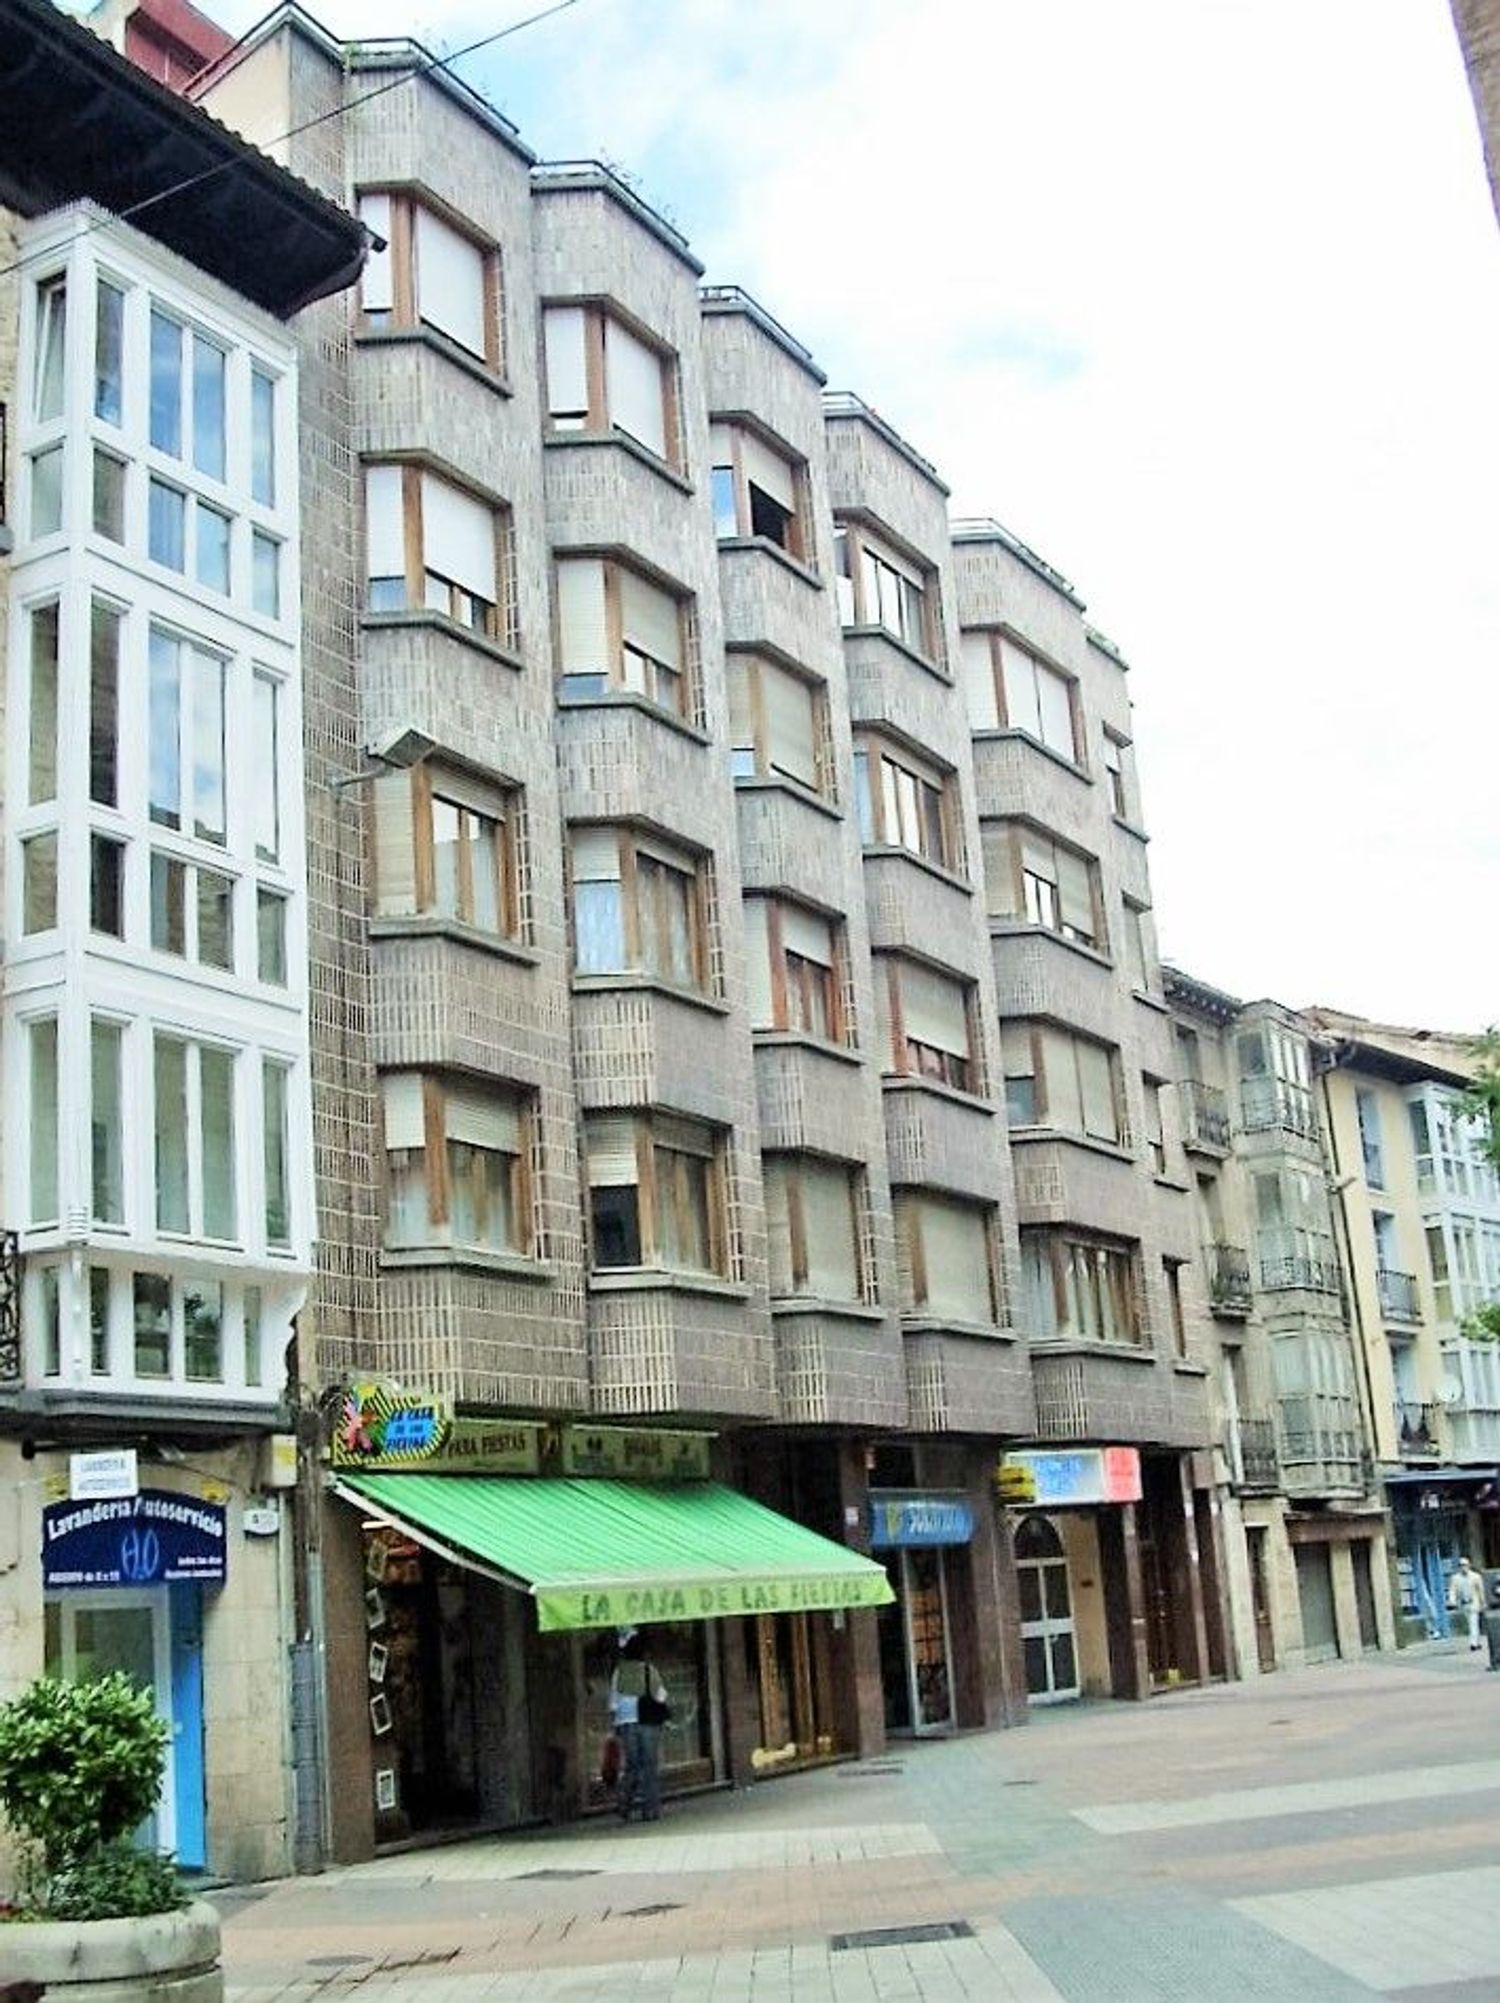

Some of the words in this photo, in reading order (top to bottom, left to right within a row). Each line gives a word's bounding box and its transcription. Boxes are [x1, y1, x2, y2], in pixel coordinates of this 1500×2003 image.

[583, 1594, 611, 1622] LA
[700, 1587, 729, 1613] DE
[741, 1584, 779, 1609] LAS
